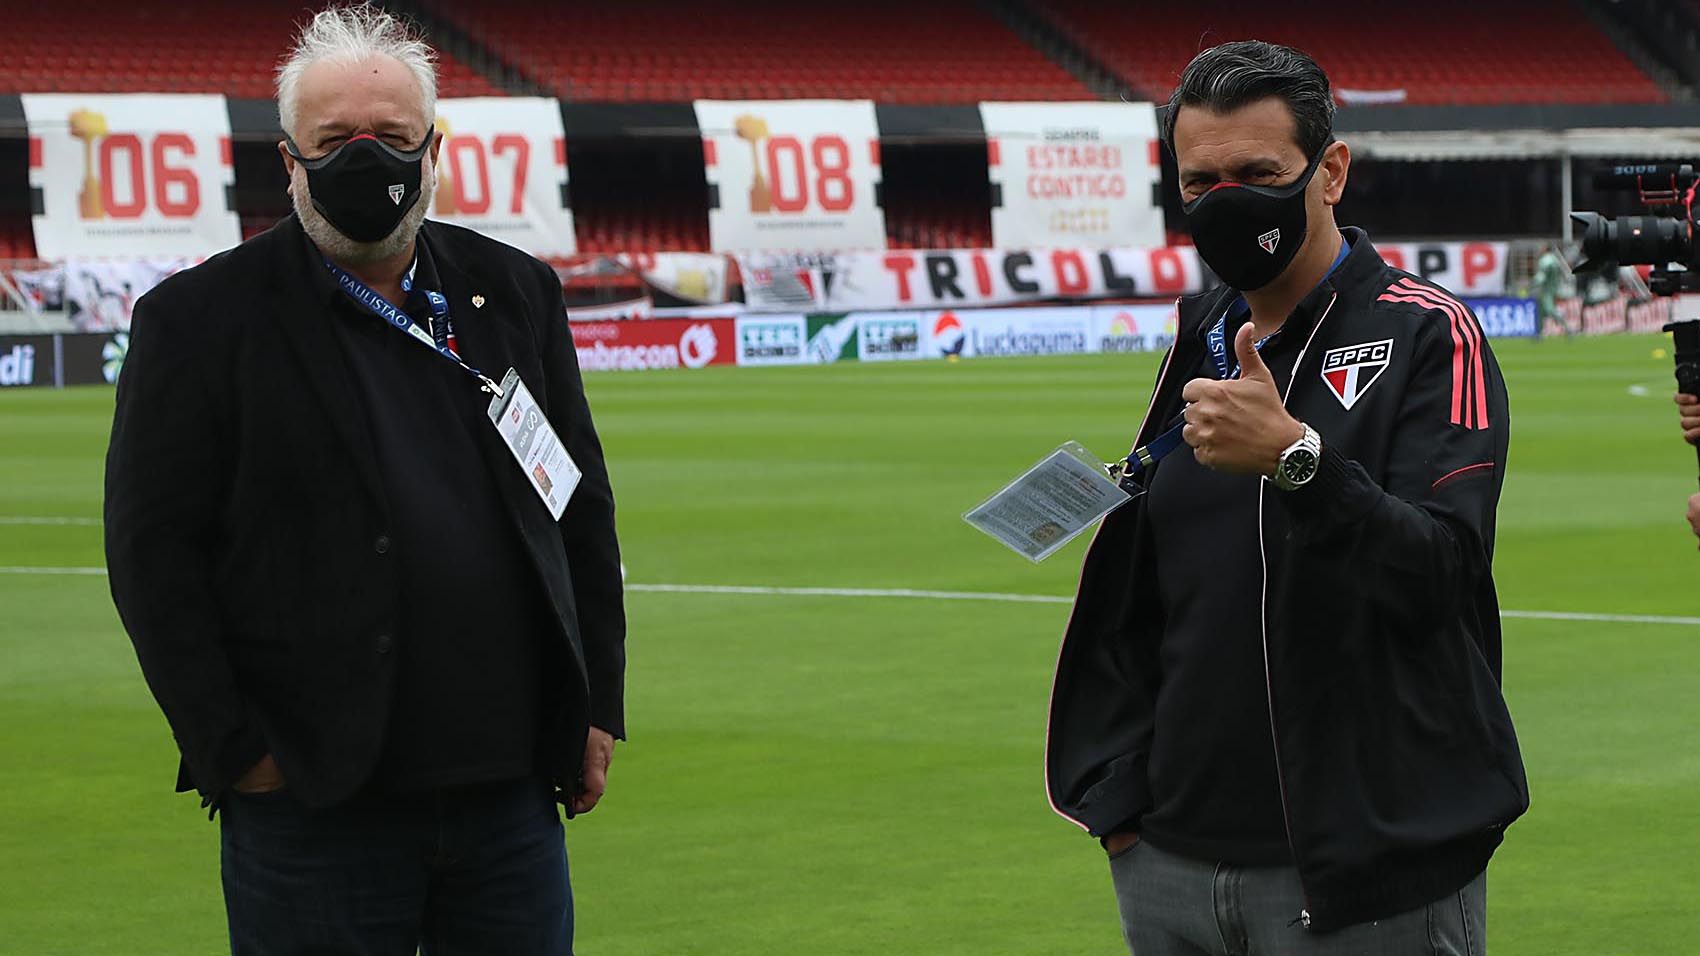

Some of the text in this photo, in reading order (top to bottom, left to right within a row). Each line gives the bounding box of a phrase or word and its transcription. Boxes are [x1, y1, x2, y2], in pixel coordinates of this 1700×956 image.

[100, 133, 200, 218] 06
[446, 135, 530, 214] 07
[767, 134, 854, 213] 08
[1027, 145, 1121, 168] ESTAREI
[1027, 175, 1126, 199] CONTIGO
[1328, 345, 1385, 367] SPFC
